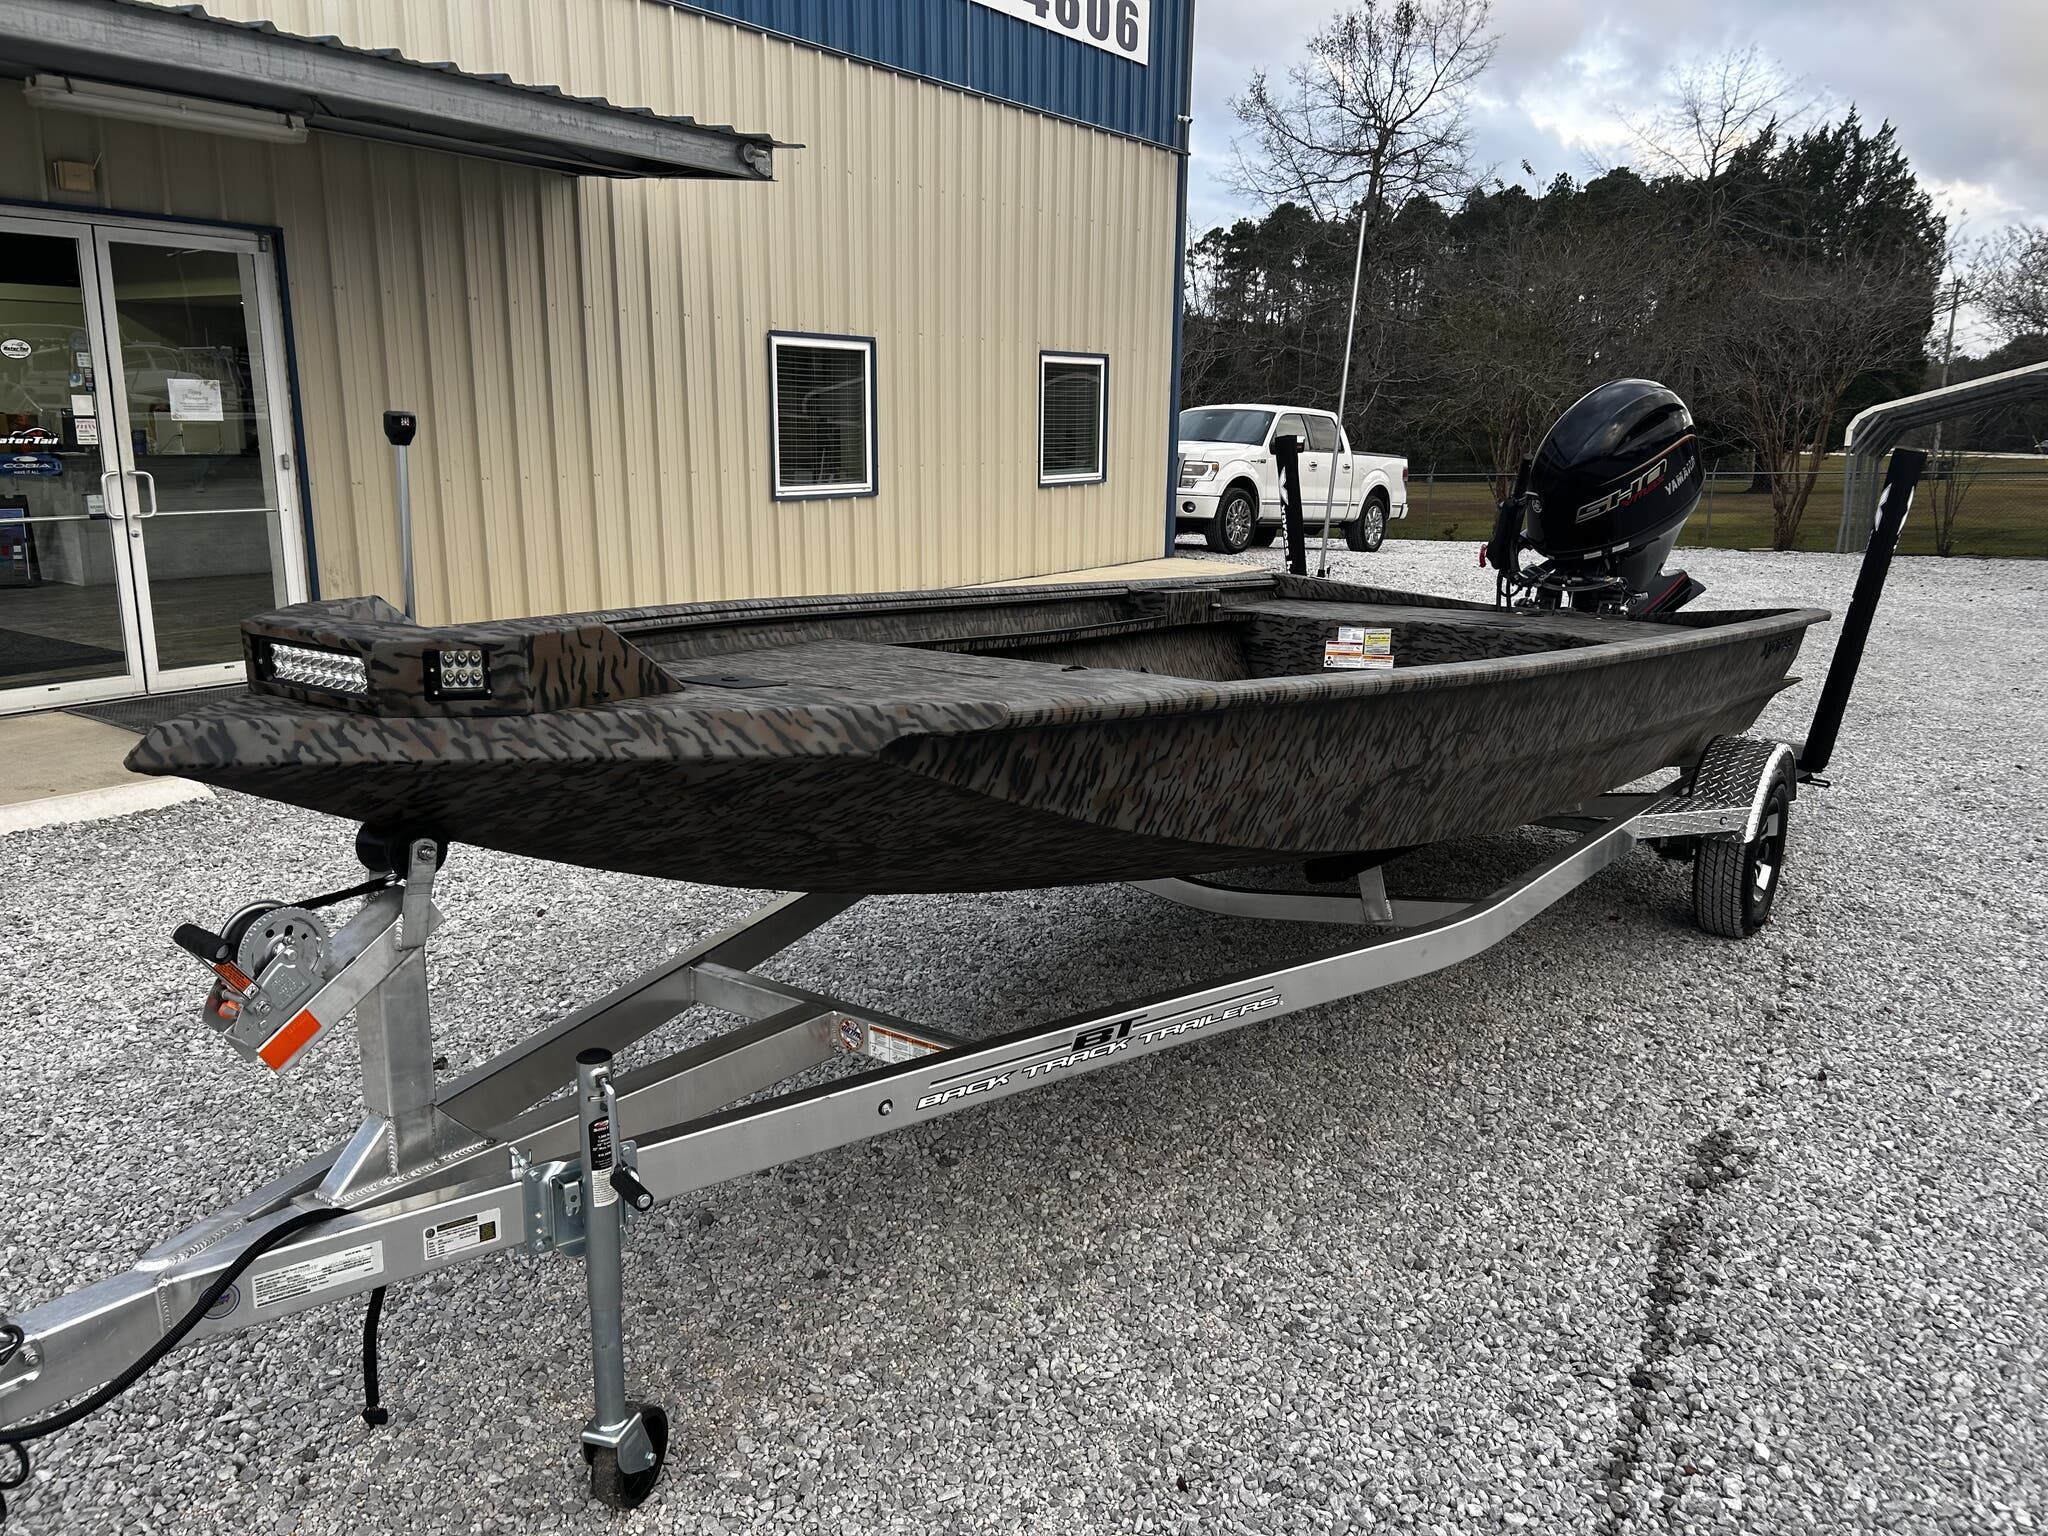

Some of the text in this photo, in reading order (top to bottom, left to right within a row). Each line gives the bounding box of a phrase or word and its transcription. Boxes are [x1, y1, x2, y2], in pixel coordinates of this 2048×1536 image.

[0, 436, 59, 445] atorTail
[1664, 455, 1696, 496] YAMAHA
[1071, 1014, 1148, 1051] BT
[915, 994, 1282, 1111] BACK TRACK TRAILERS
